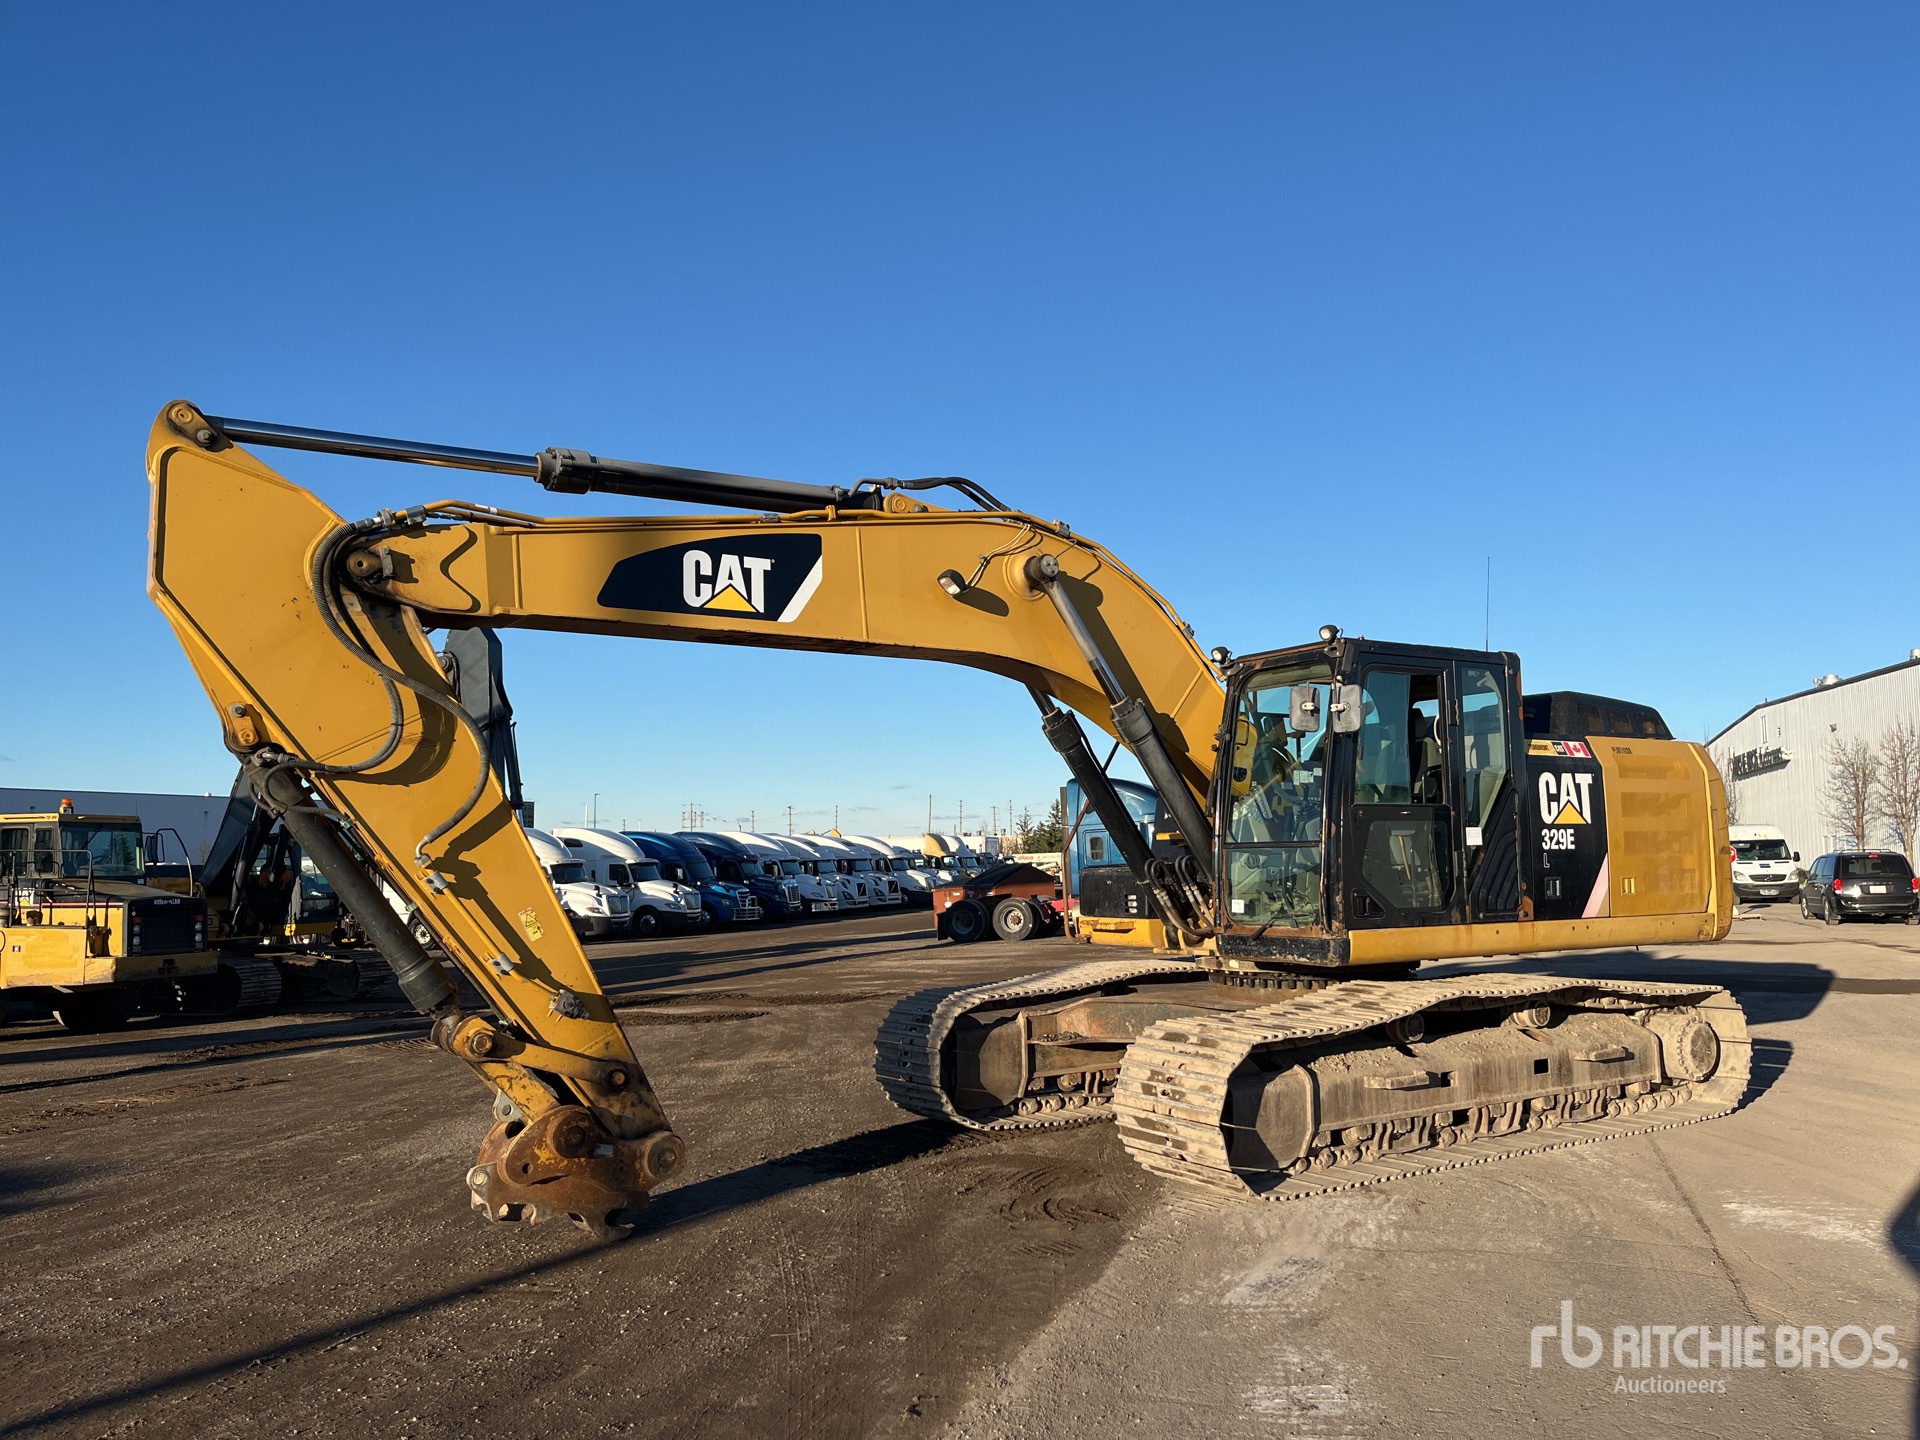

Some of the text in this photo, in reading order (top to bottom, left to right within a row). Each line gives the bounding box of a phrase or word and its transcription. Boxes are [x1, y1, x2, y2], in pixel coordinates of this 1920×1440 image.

[683, 549, 771, 614] CAT
[1538, 771, 1593, 825] CAT
[1541, 828, 1575, 850] 329E
